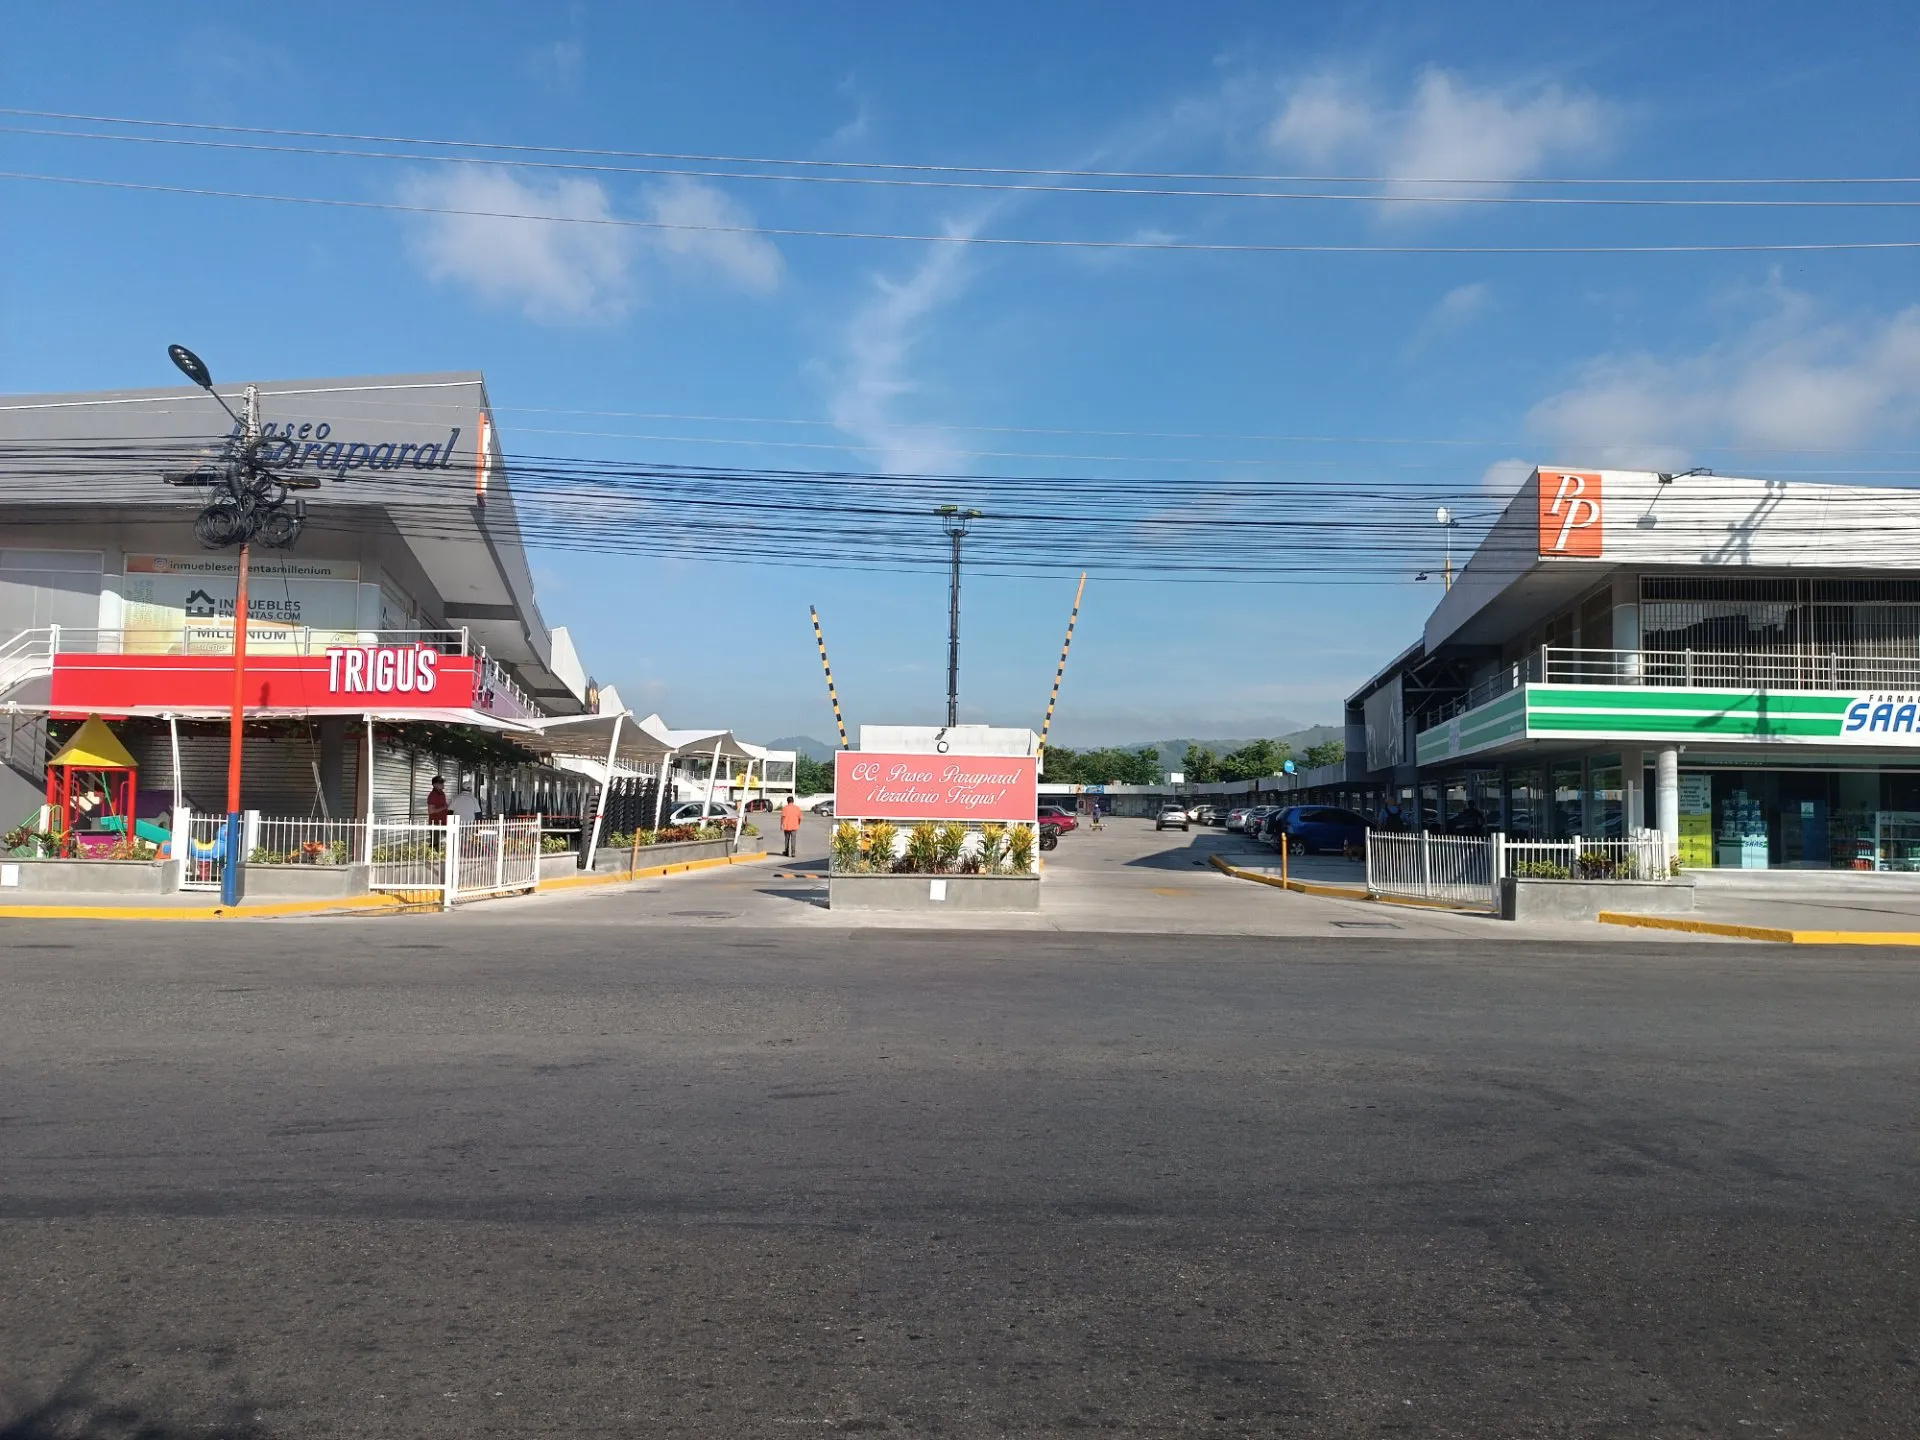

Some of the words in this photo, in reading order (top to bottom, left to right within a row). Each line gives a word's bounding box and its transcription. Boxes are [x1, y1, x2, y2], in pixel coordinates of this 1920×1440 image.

[237, 421, 331, 446] aseo
[169, 560, 331, 575] inmueblesenentasmillenium
[219, 598, 301, 612] INUEBLES
[218, 609, 301, 621] ENNTAS.COM
[197, 627, 287, 641] MILLNIUM
[1846, 703, 1920, 733] SAA
[886, 763, 933, 783] Paseo
[938, 764, 1022, 789] Paraparal
